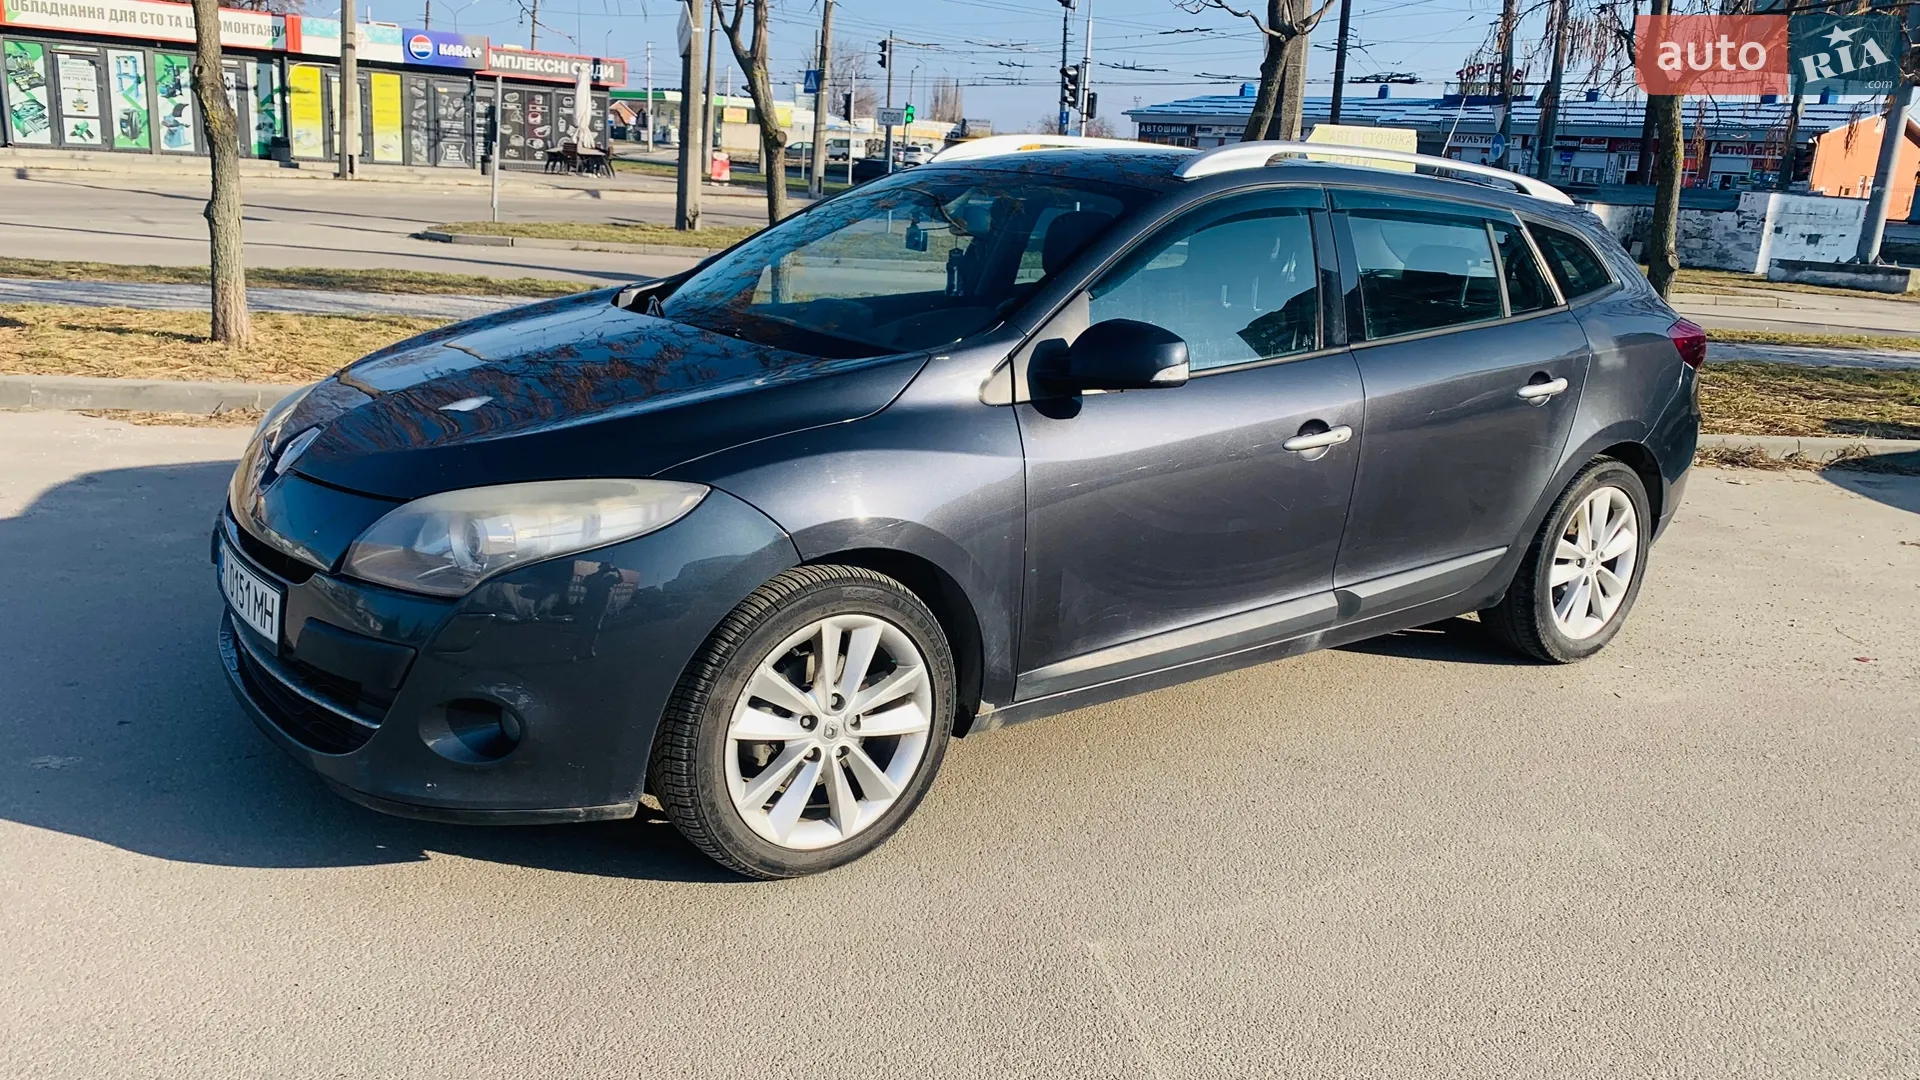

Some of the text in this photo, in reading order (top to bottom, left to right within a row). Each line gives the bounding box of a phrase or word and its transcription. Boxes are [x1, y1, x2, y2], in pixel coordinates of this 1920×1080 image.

[10, 0, 280, 37] ОБЛАДНАННЯ ДЛЯ СТО ТА ШМОНТАЖУ
[491, 53, 569, 74] МПЛЕКСНІ
[1140, 124, 1187, 133] АВТОШИНИ
[253, 585, 275, 635] MH
